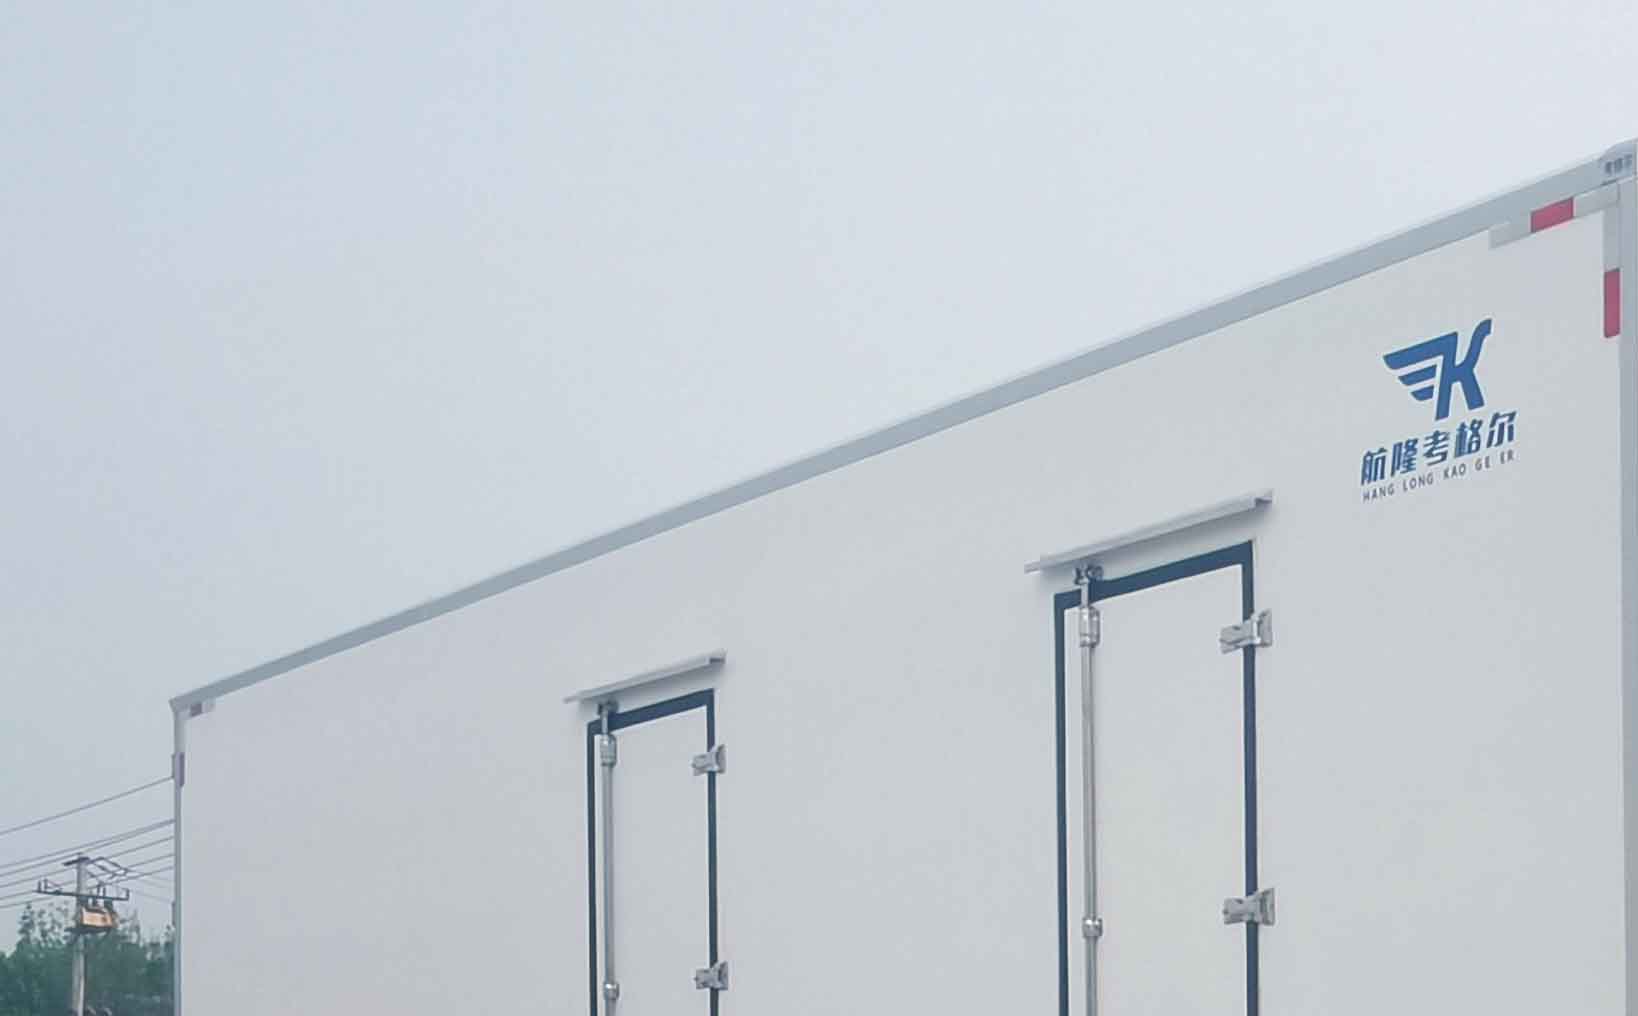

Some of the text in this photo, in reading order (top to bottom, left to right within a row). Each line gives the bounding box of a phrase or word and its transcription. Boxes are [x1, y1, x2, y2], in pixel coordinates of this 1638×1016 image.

[1360, 410, 1518, 486] 航隆考格尔
[1363, 449, 1515, 502] HANG LONG KAO GE ER
